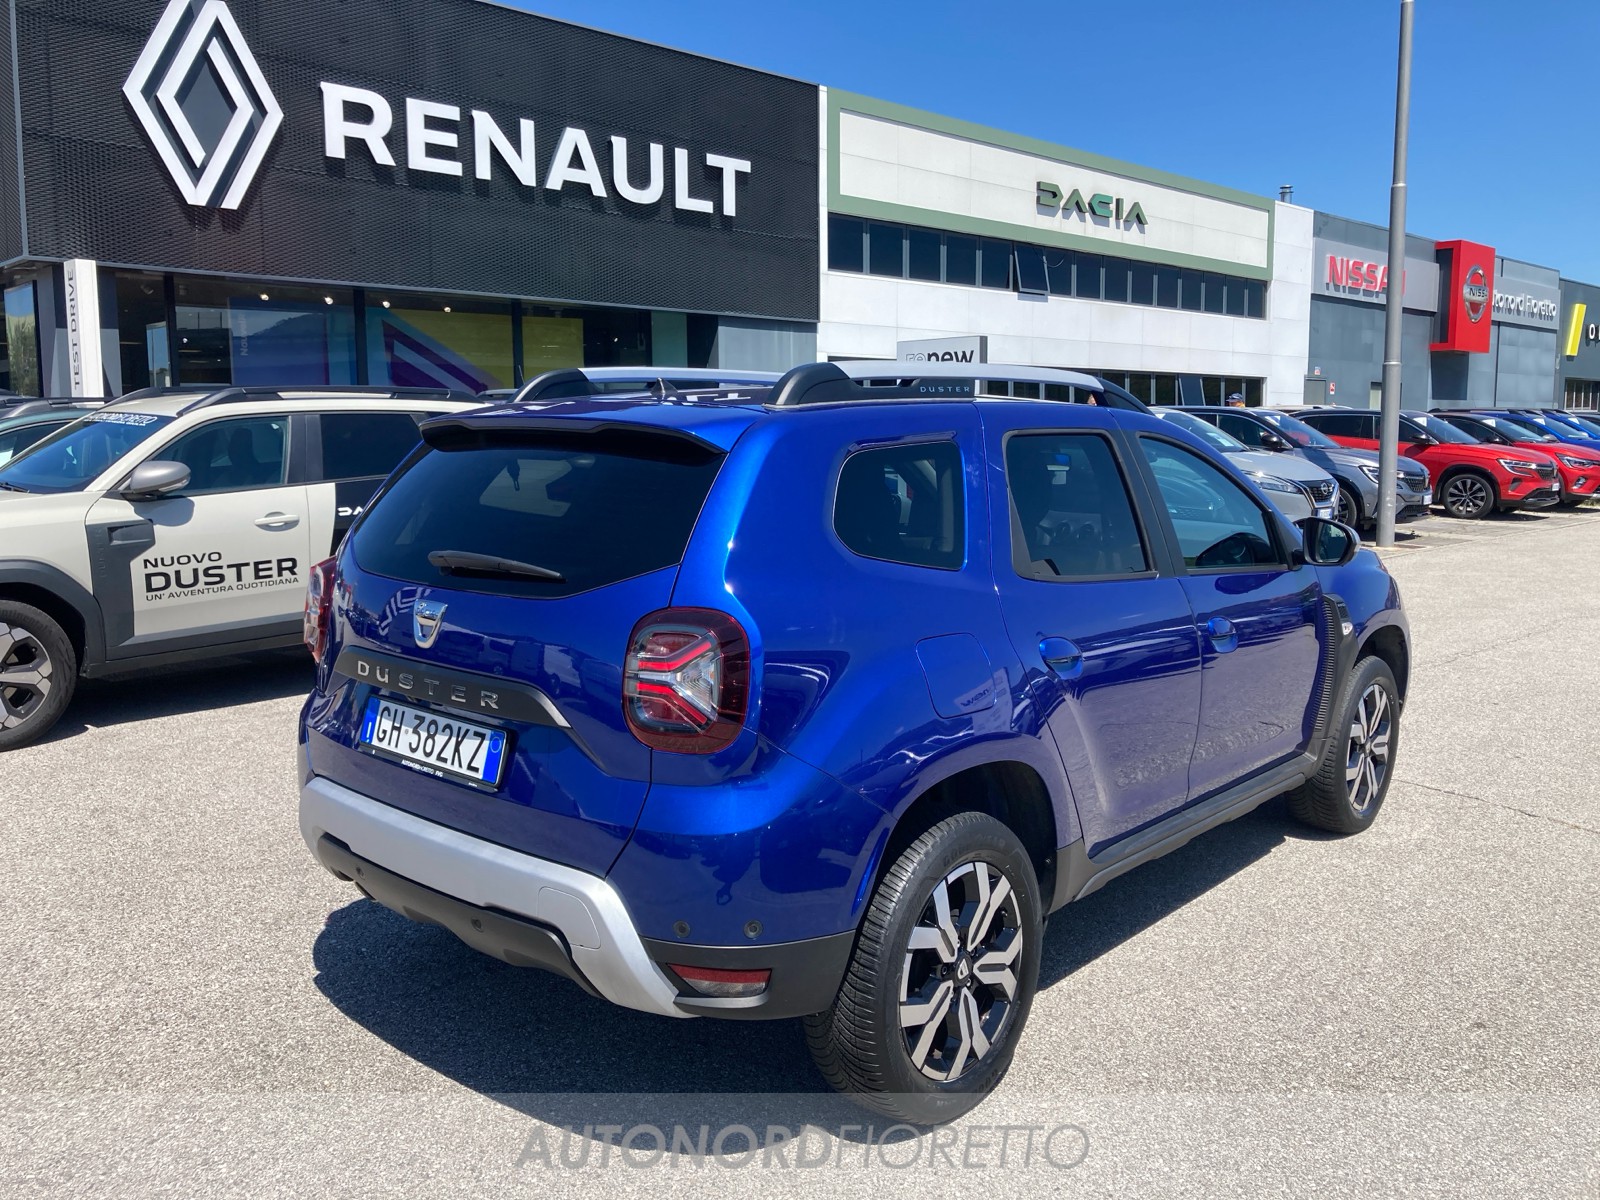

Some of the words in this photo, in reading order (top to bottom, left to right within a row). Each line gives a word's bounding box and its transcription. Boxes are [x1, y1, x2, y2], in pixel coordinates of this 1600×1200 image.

[320, 81, 751, 216] RENAULT
[1036, 180, 1149, 225] DACIA
[67, 268, 77, 333] DRIVE
[1525, 295, 1557, 317] Fioretto
[71, 339, 80, 390] TEST
[905, 349, 975, 363] renew
[143, 551, 222, 570] NUOVO
[144, 557, 298, 593] DUSTER
[145, 593, 165, 602] UN'
[167, 585, 234, 600] AVVENTURA
[236, 577, 299, 591] QUOTIDIANA
[357, 660, 499, 710] DUSTER
